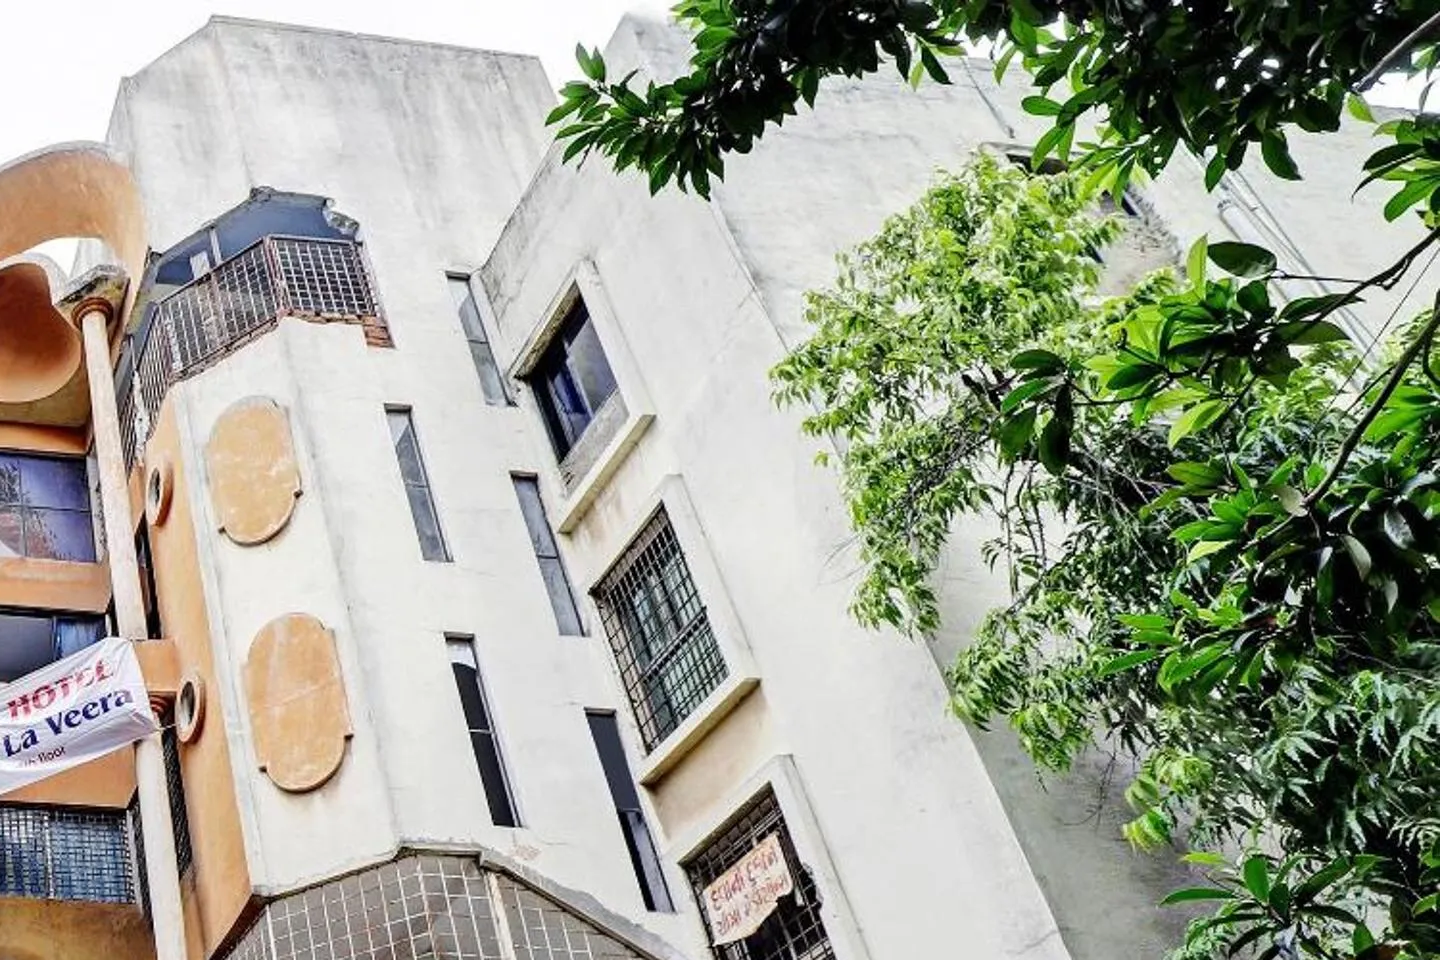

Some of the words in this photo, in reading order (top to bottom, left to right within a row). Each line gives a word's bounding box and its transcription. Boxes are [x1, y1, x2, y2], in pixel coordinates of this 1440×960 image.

[3, 728, 40, 757] La
[45, 687, 135, 736] Veera
[6, 658, 116, 720] HOTEL
